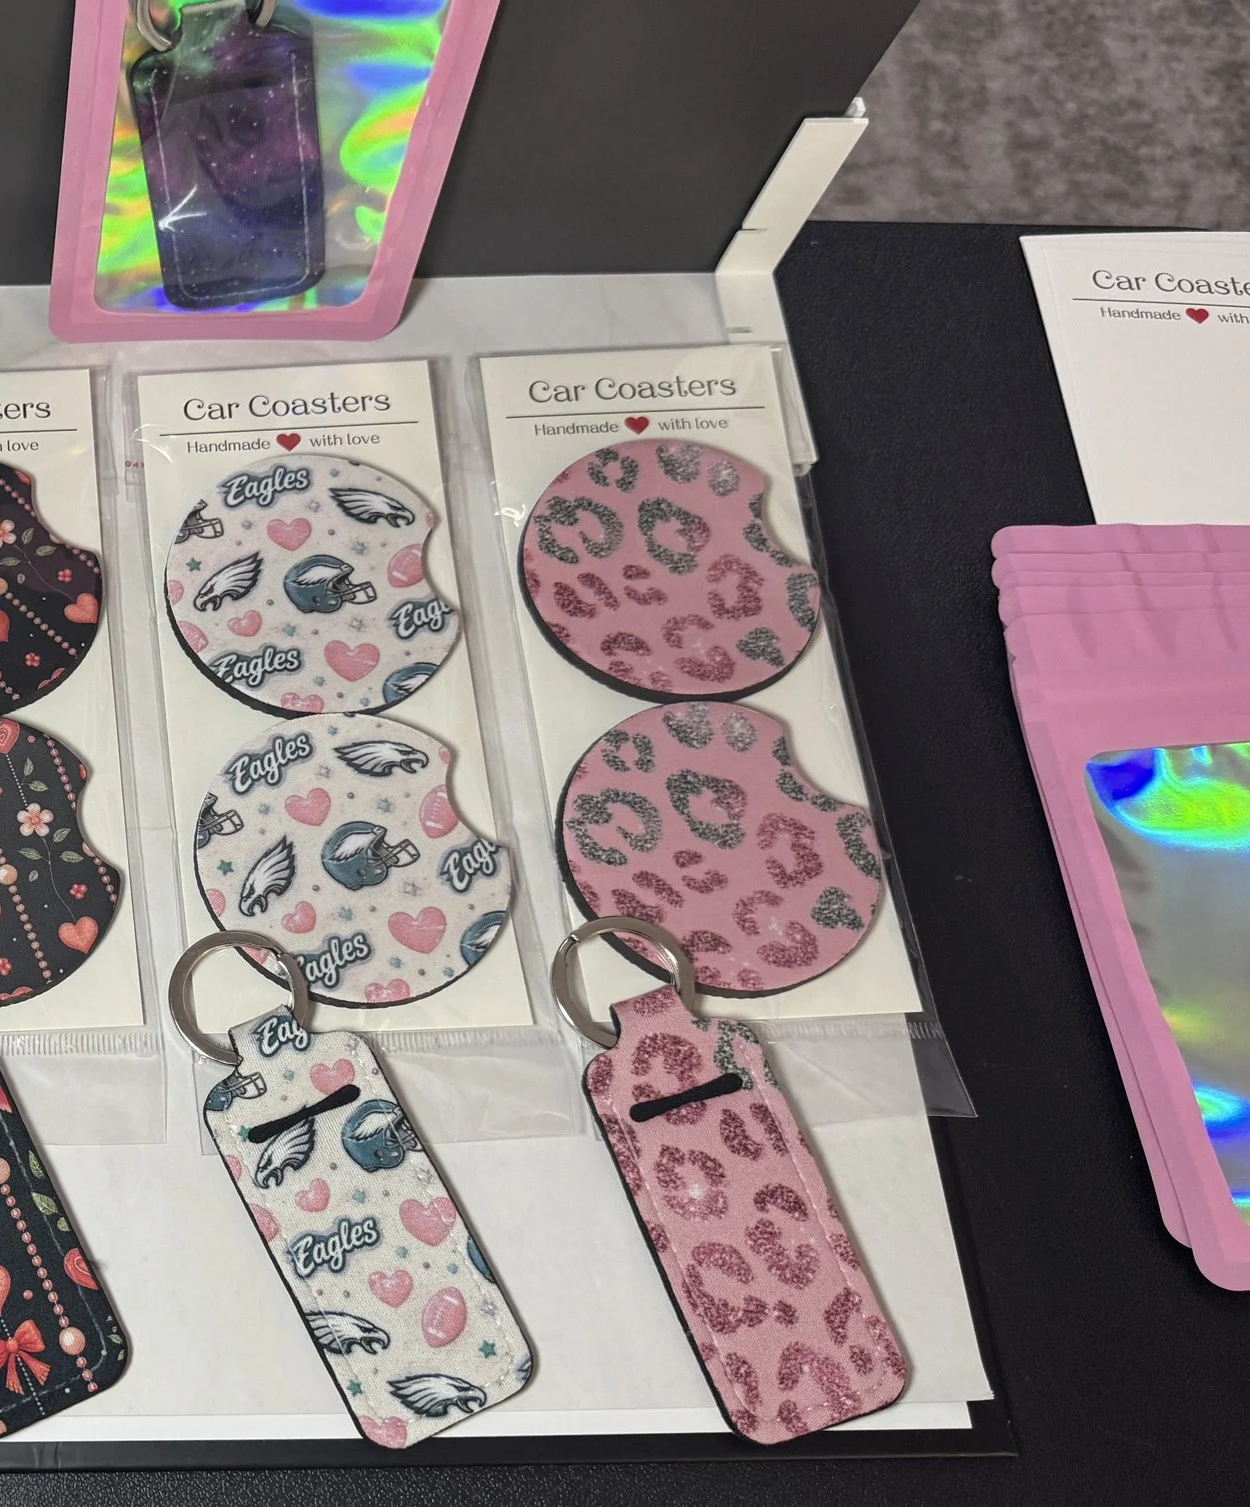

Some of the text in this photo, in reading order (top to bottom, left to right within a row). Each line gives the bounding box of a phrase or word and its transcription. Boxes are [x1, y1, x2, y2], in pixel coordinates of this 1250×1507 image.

[1092, 269, 1146, 291] Car
[1100, 307, 1250, 324] Handmade with
[528, 375, 737, 403] Car Coasters
[183, 392, 391, 421] Car Coasters
[534, 417, 728, 436] Handmade with love
[7, 440, 39, 452] love
[187, 433, 381, 453] Handmade with love
[220, 465, 311, 508] Eagles
[227, 732, 312, 794] Eagles
[296, 933, 370, 987] agles
[290, 1216, 380, 1278] Eagles
